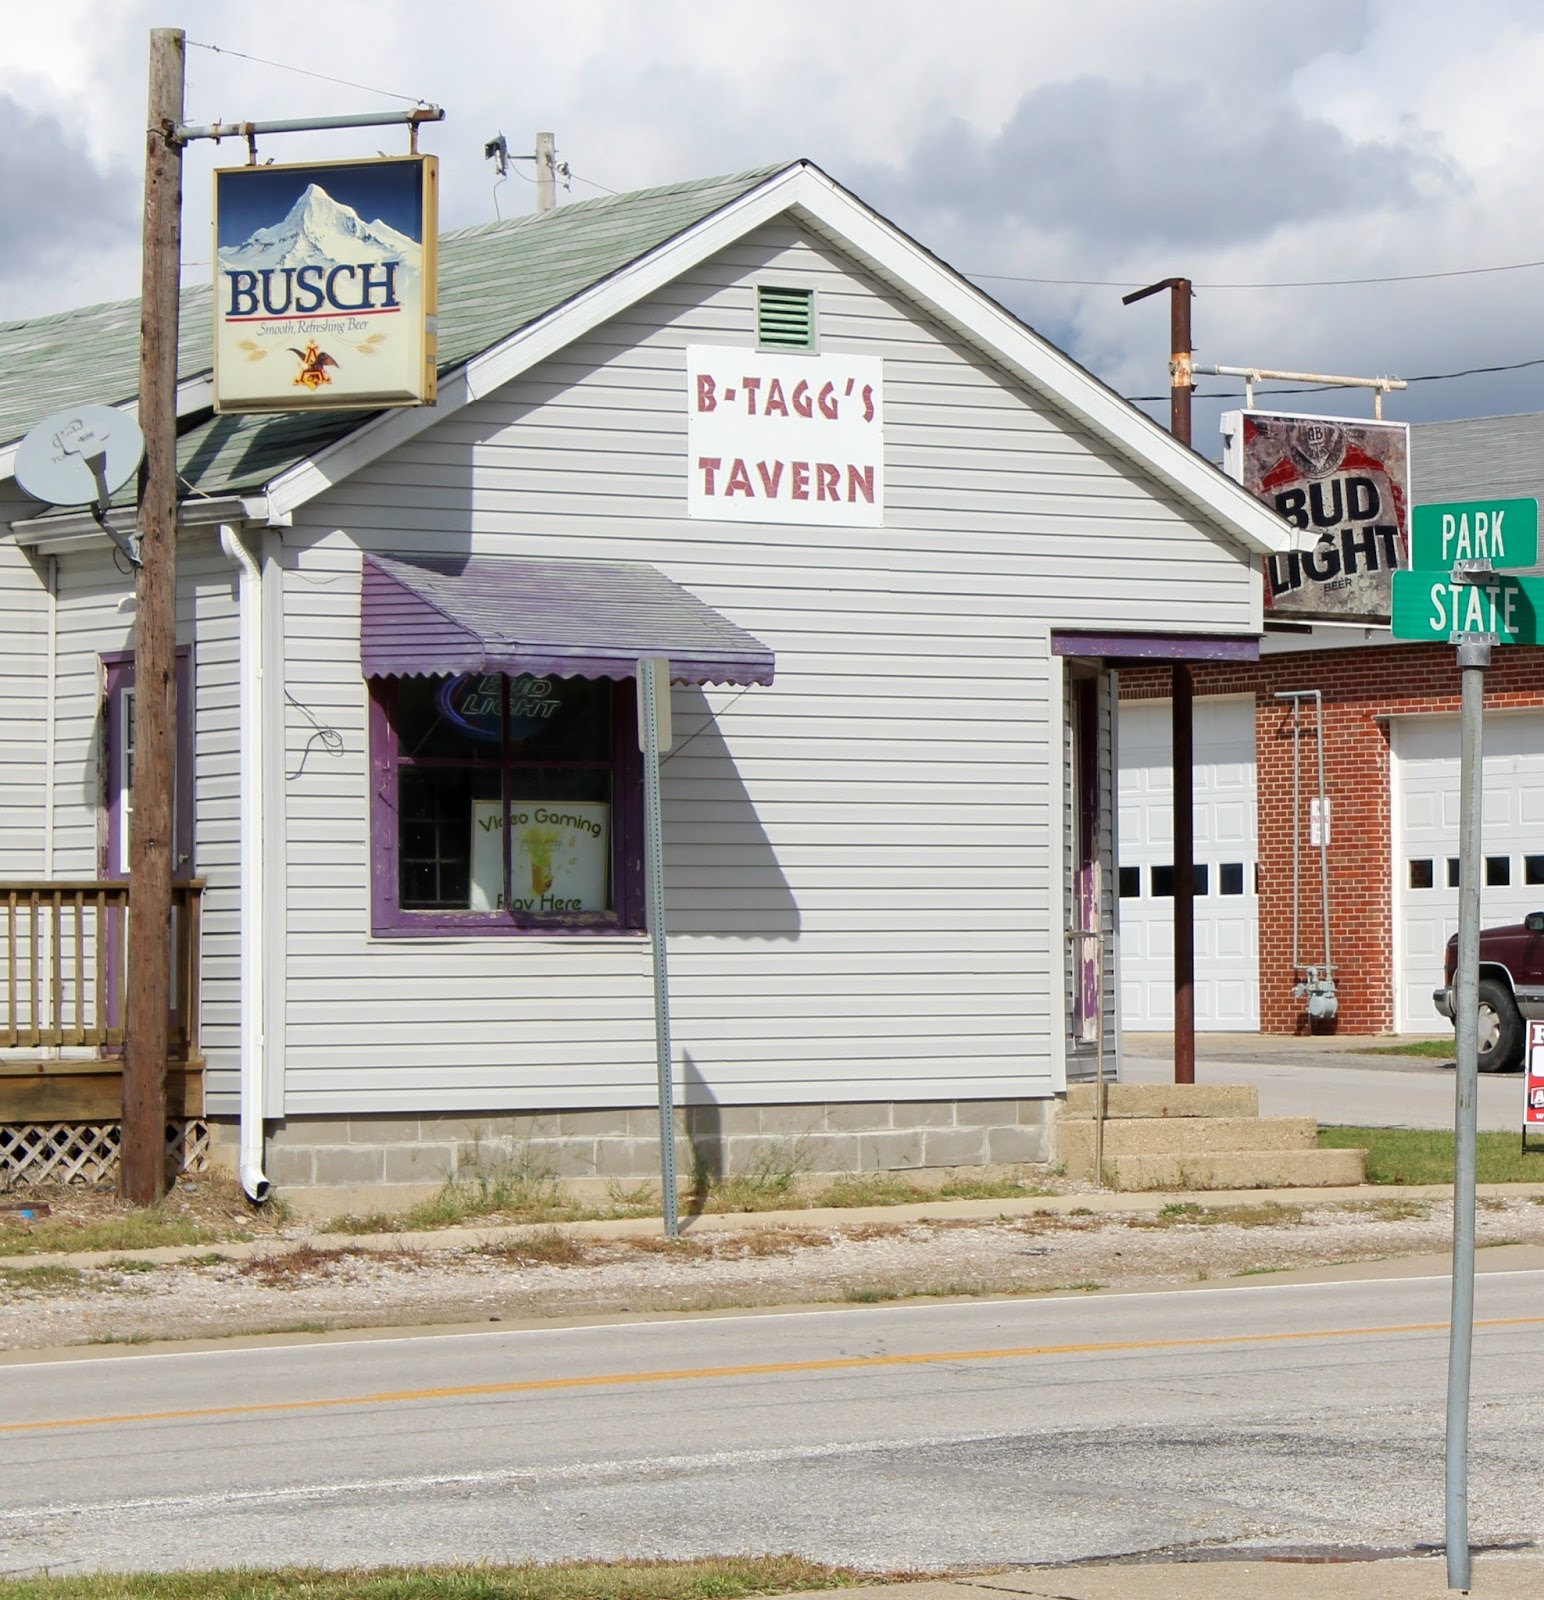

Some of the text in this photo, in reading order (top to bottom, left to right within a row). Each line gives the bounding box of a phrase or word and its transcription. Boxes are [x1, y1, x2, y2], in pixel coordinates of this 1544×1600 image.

[225, 261, 401, 316] BUSCH
[257, 317, 369, 336] Smooth, Refreshing Beer
[697, 374, 875, 423] B-TAGG'S
[698, 456, 875, 504] TAVERN
[1275, 477, 1380, 530] BUD
[1442, 510, 1505, 560] PARK
[1268, 525, 1399, 596] LIGHT
[1324, 579, 1353, 593] BEER
[1429, 583, 1520, 634] STATE
[460, 688, 561, 718] LIGHT
[534, 808, 602, 838] Gaming
[496, 893, 582, 911] Pay Here
